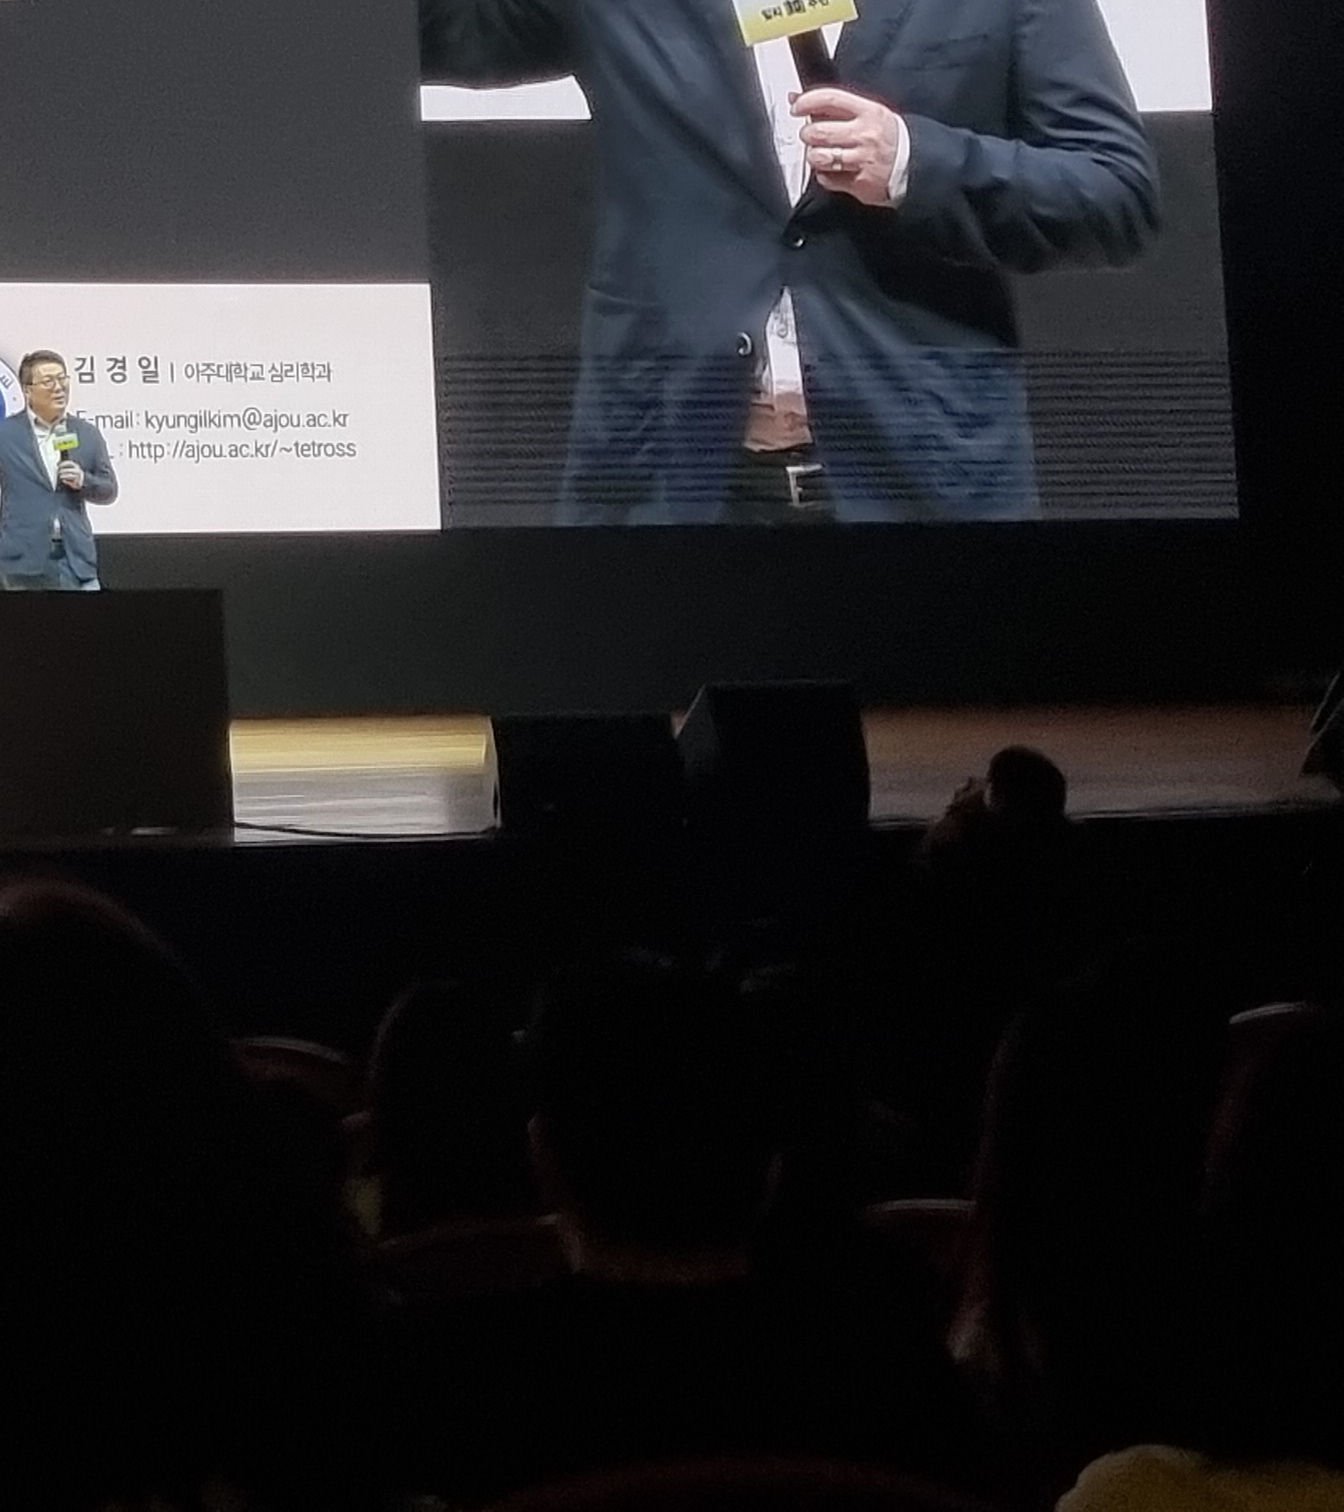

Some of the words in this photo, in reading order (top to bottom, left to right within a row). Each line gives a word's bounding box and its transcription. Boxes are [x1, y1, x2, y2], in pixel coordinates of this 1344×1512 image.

[184, 361, 265, 383] 아주대학교
[268, 361, 333, 383] 심리학과
[145, 407, 349, 433] kyungilkim@ajou.ac.kr
[128, 439, 357, 464] http://ajou.ac.kr/~tetross
